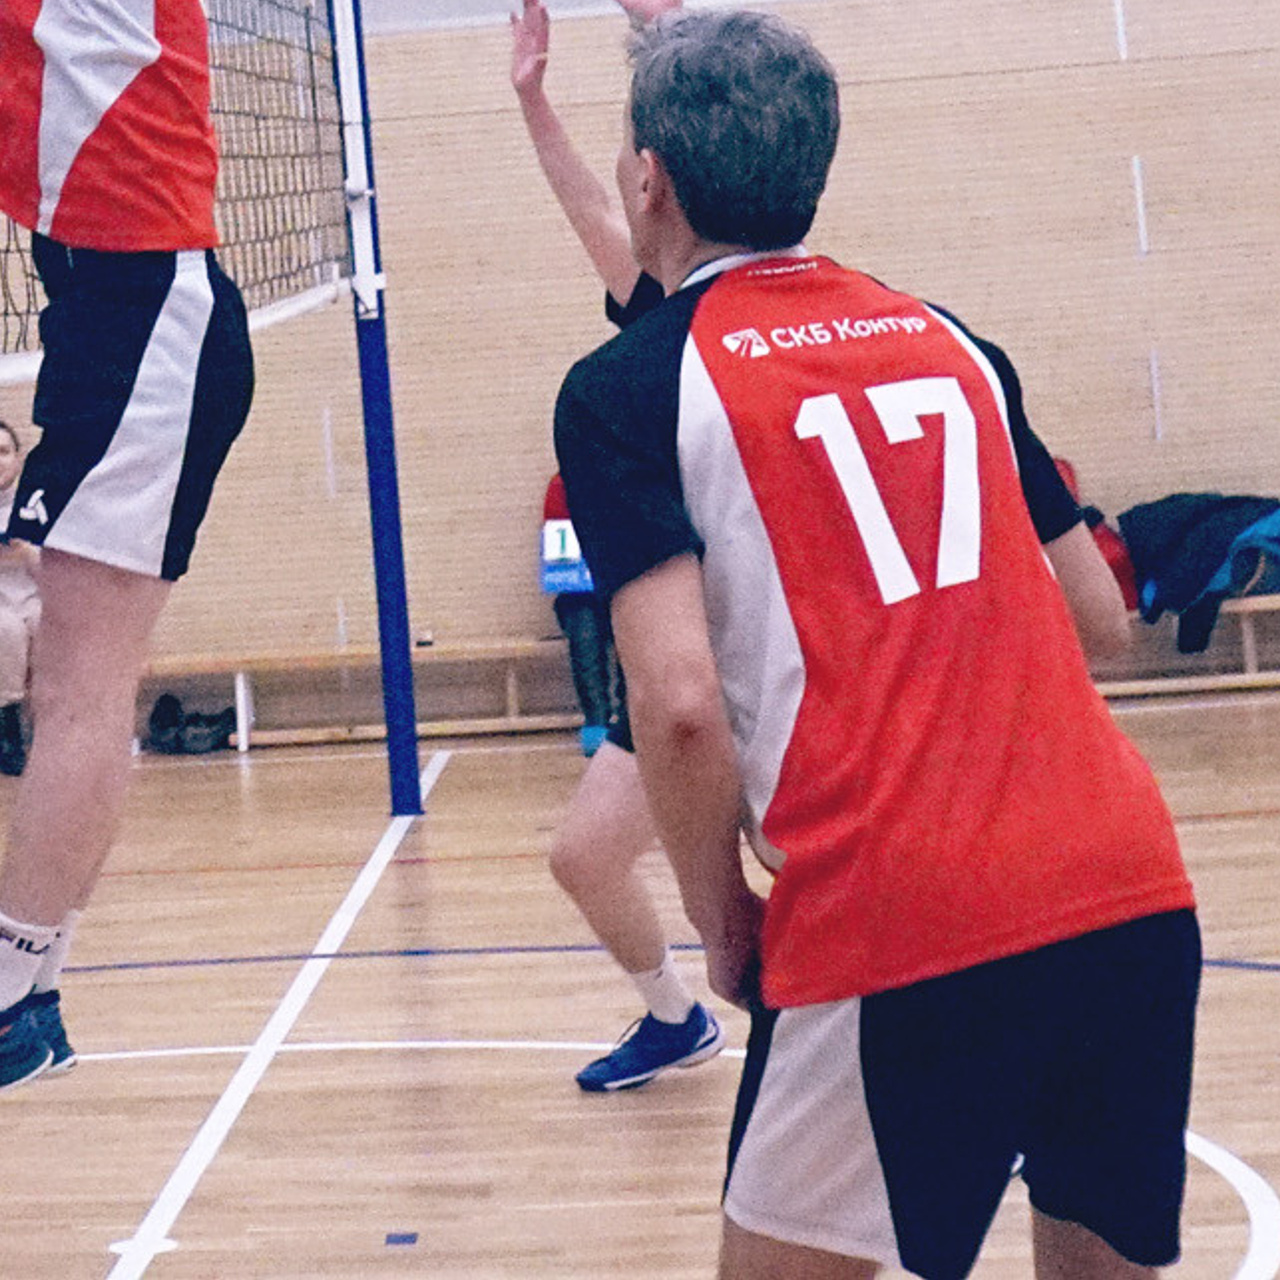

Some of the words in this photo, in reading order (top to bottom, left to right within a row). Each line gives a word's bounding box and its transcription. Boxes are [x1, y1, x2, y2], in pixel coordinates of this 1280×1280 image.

[770, 322, 833, 349] СКБ
[832, 316, 927, 341] Контур
[793, 376, 981, 606] 17
[555, 527, 567, 555] 1
